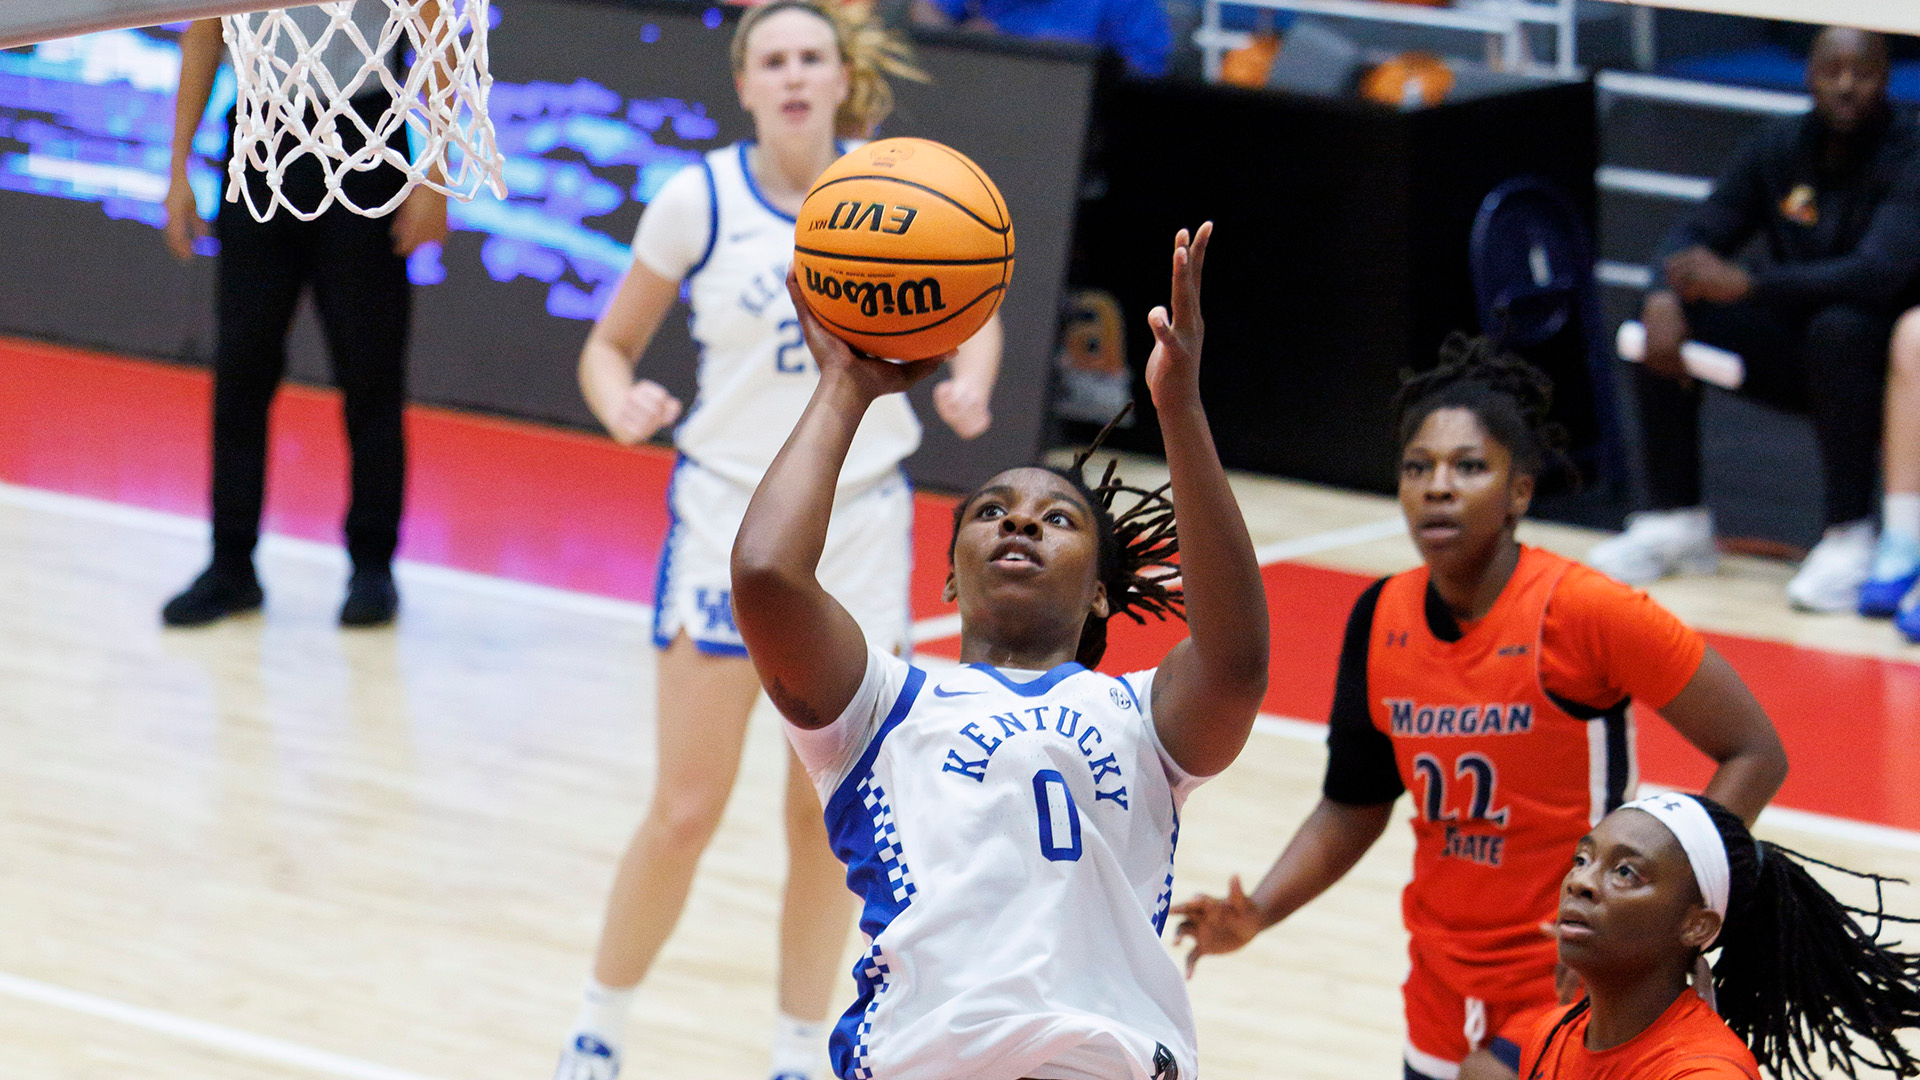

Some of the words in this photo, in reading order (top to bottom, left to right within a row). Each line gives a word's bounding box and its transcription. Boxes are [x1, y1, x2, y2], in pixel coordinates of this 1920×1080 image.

[808, 220, 828, 232] NXT
[827, 201, 918, 235] EVO
[805, 266, 947, 317] Wilson
[776, 318, 806, 373] 2
[1382, 699, 1534, 737] MORGAN
[942, 706, 1129, 811] KENTUCKY
[1032, 769, 1083, 862] 0
[1413, 752, 1511, 826] 22
